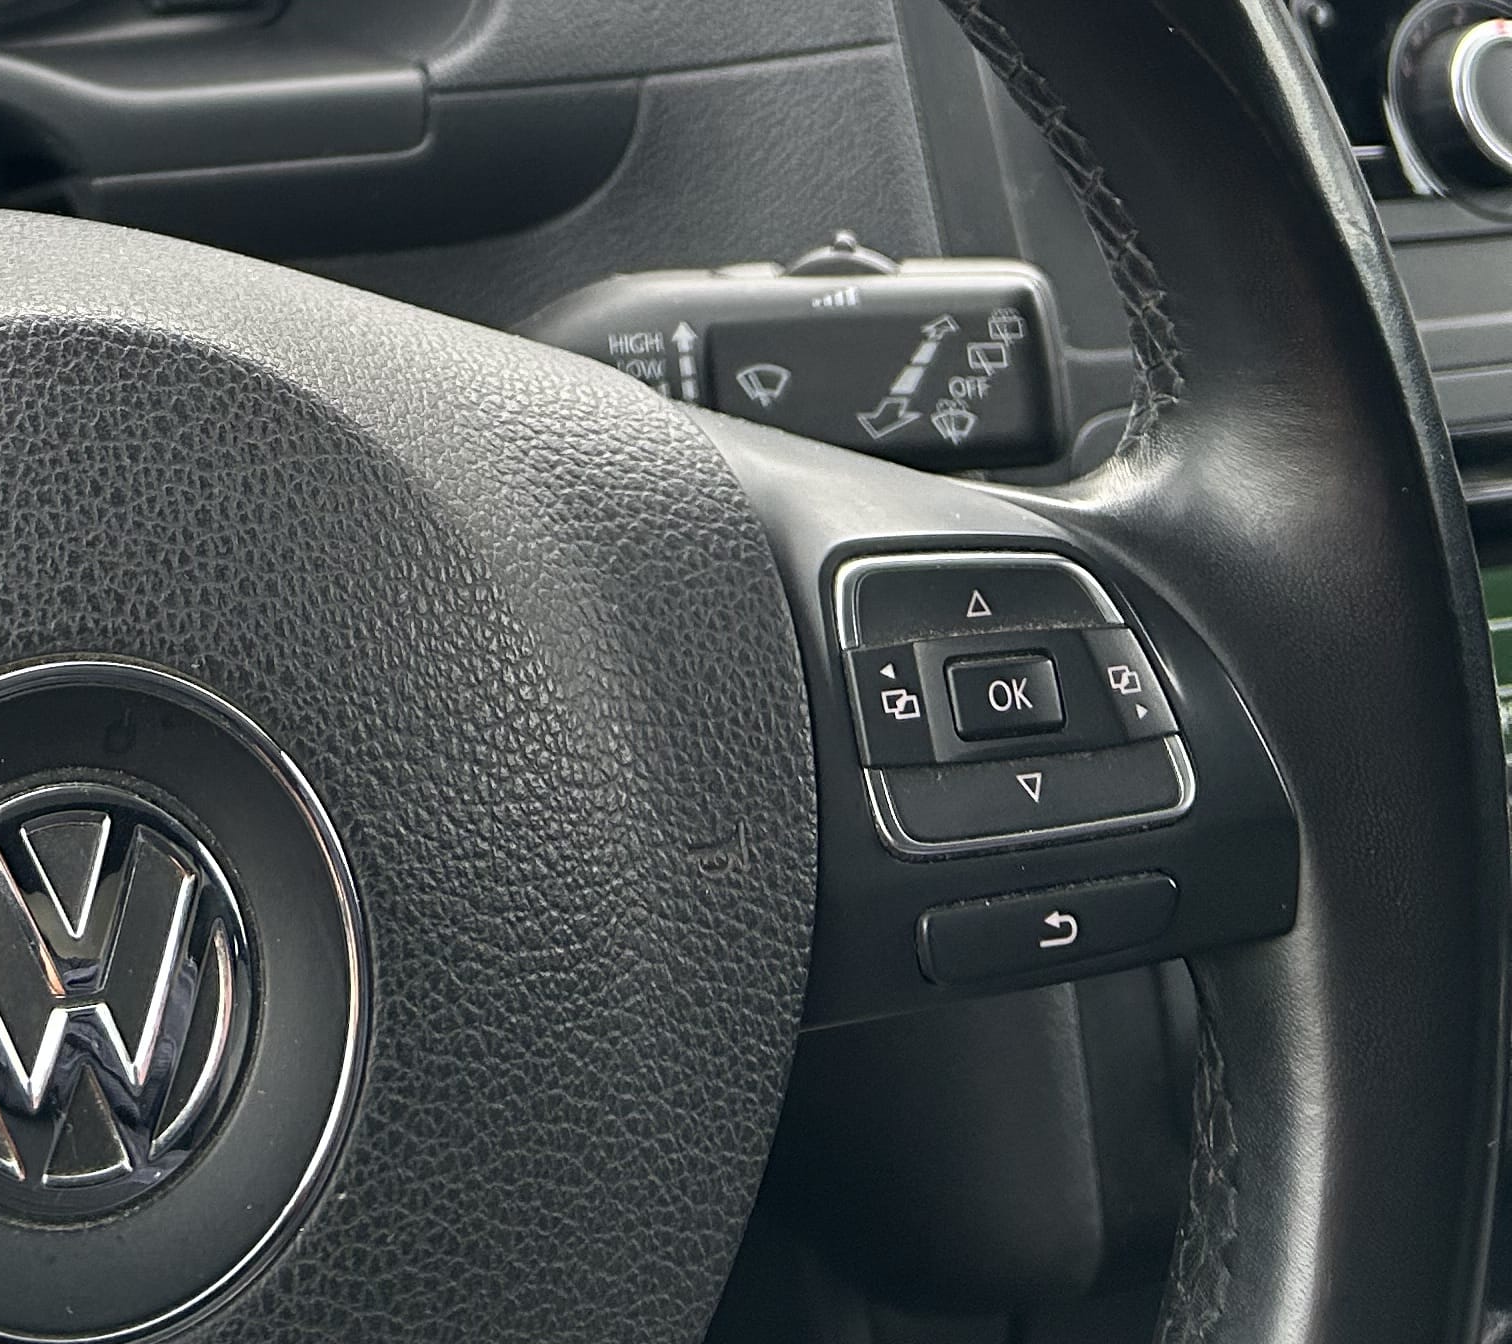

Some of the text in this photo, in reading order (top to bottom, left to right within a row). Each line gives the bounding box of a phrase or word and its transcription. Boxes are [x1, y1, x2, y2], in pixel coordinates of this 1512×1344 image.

[608, 331, 665, 354] HIGH
[948, 375, 990, 399] OFF
[988, 678, 1033, 711] OK
